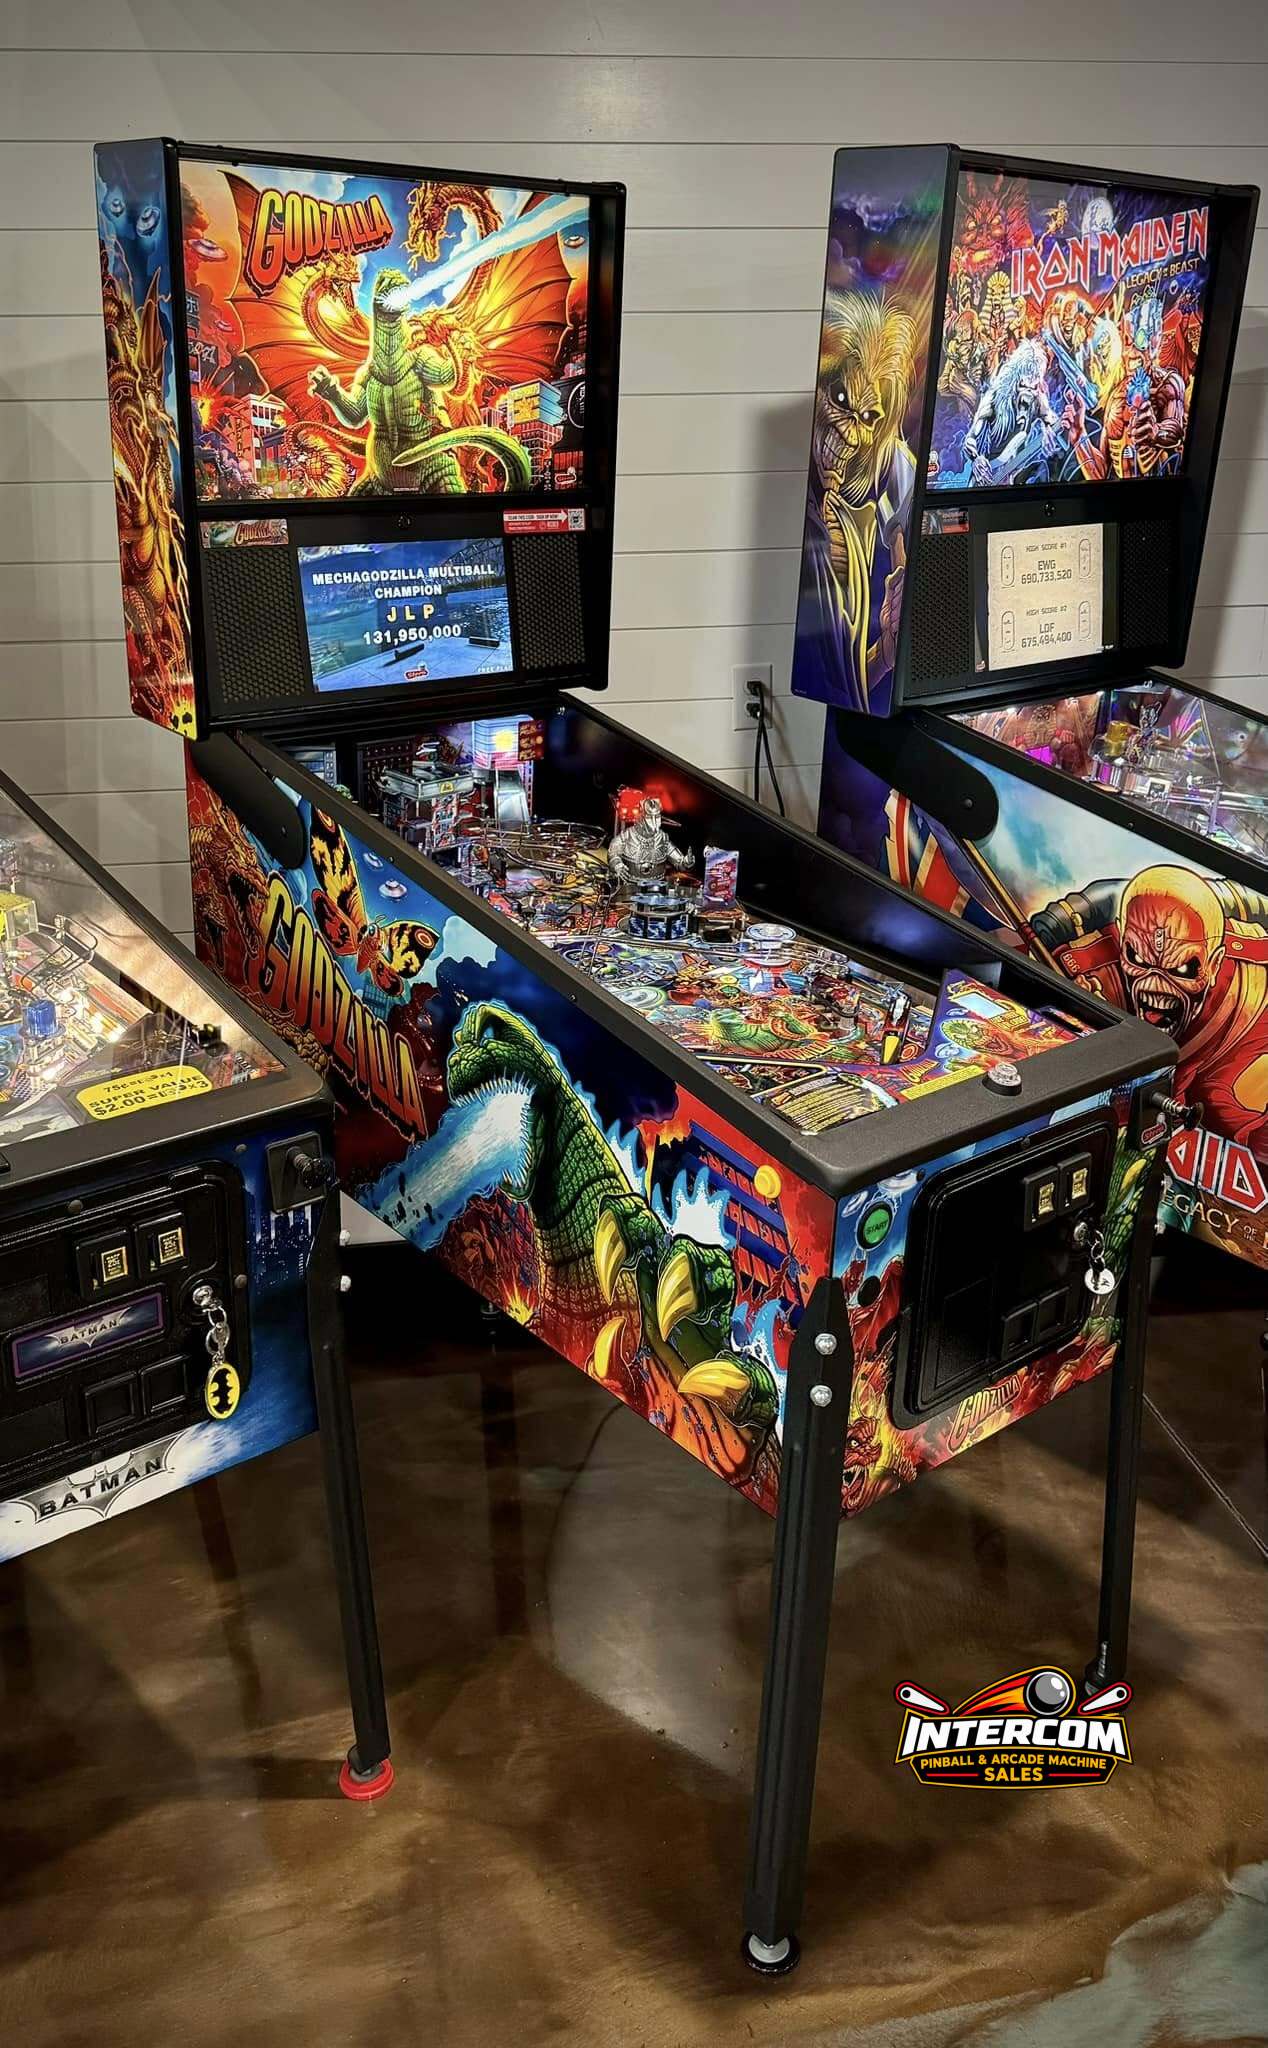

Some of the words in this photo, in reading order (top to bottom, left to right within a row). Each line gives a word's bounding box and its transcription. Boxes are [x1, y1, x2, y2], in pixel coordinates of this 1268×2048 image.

[246, 189, 393, 294] GODZILLA
[1011, 234, 1090, 304] IRON
[1097, 206, 1210, 281] MAIDEN
[1126, 268, 1161, 288] LEGACY
[1169, 257, 1200, 277] BEAST
[312, 569, 425, 586] MECHAGODZILLA
[428, 564, 495, 578] MULTIBALL
[1021, 569, 1072, 585] 690,733,520
[1037, 560, 1056, 571] EWG
[374, 584, 443, 600] CHAMPION
[387, 606, 397, 622] J
[405, 605, 415, 621] L
[424, 604, 435, 619] P
[363, 623, 462, 646] 131,950,000
[1021, 631, 1072, 648] 675,494,400
[258, 873, 429, 1140] GODZILLA
[89, 1088, 146, 1108] SUPER
[60, 1319, 117, 1344] BATMAN
[948, 1375, 1020, 1451] GODZILLA
[39, 1456, 161, 1517] BATMAN
